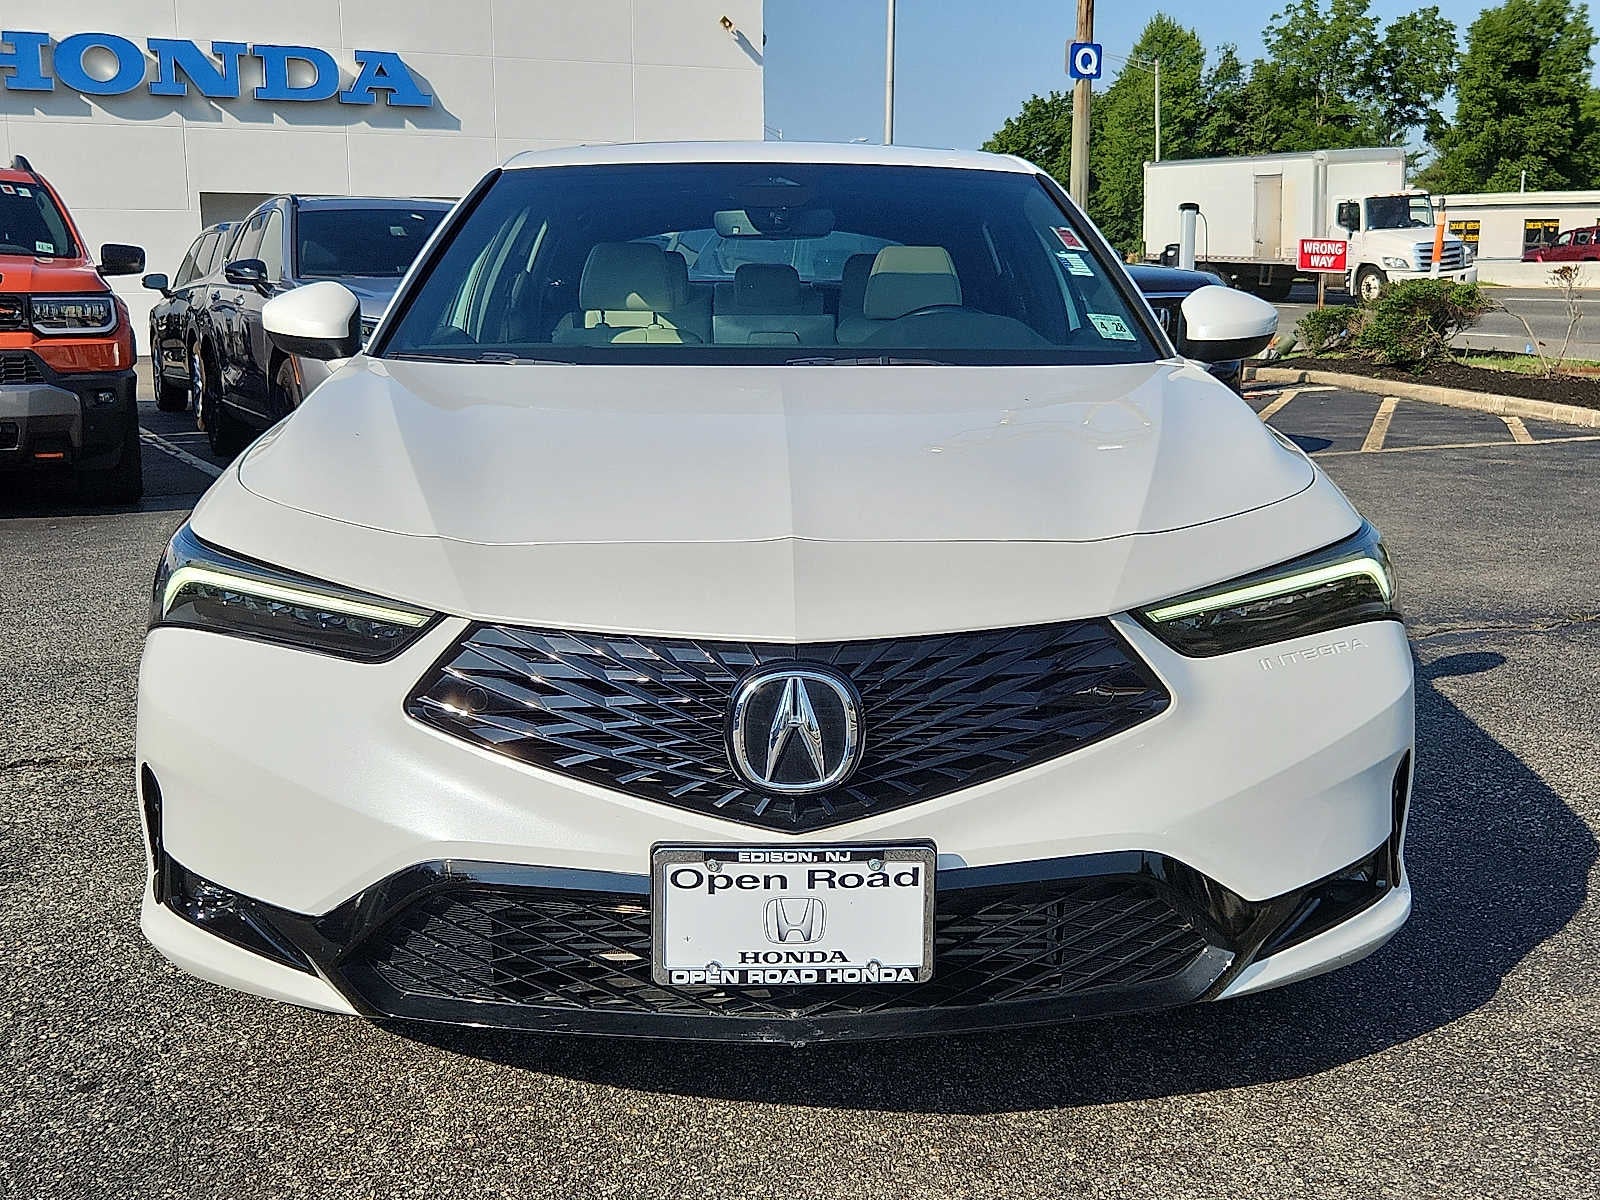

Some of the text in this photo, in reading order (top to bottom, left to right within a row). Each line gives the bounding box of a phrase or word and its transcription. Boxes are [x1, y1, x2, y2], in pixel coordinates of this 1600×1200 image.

[1075, 47, 1097, 75] Q
[1303, 241, 1345, 255] WRONG
[1310, 255, 1336, 267] WAY
[1099, 321, 1109, 332] 4
[1258, 638, 1369, 671] INTEGRA
[738, 851, 852, 863] EDISON, NJ
[670, 867, 920, 894] Open Road
[738, 950, 851, 965] HONDA
[671, 967, 916, 984] OPEN ROAD HONDA
